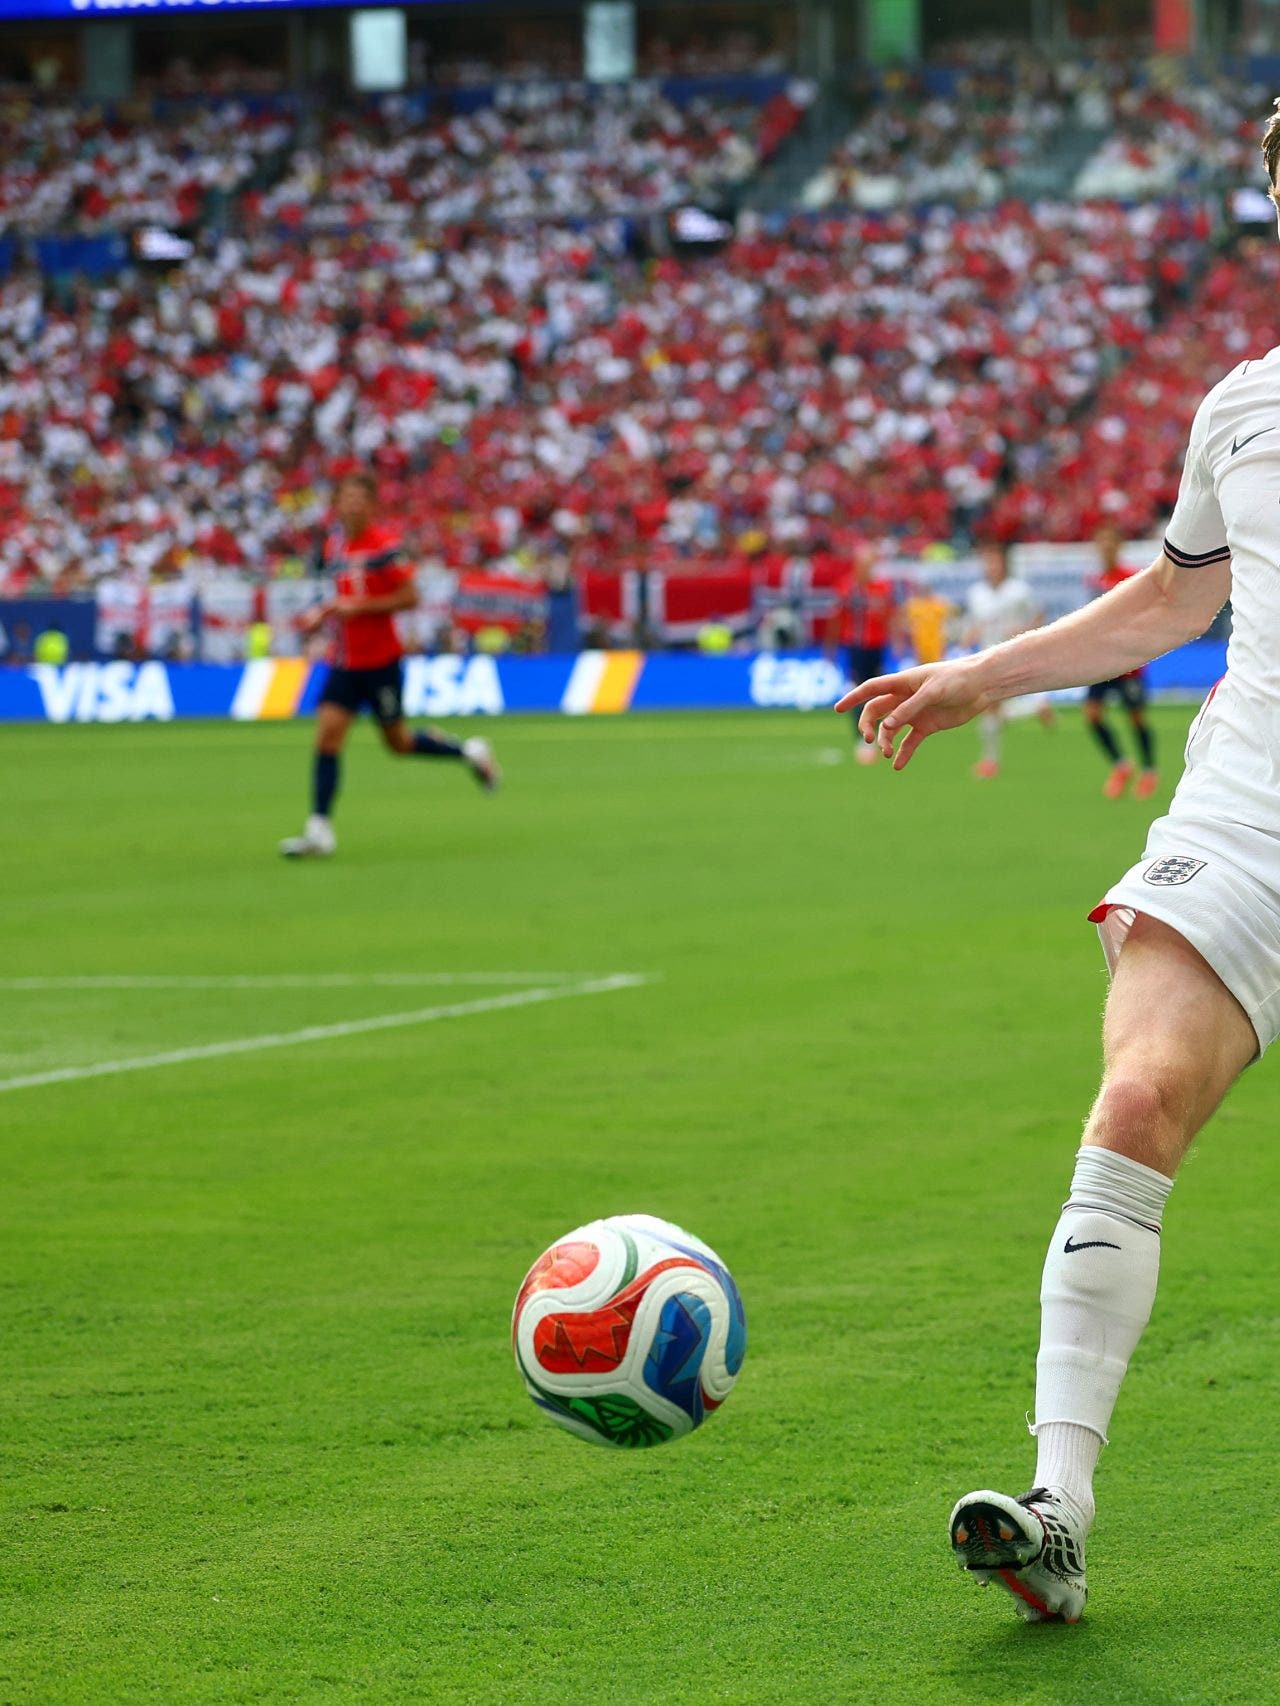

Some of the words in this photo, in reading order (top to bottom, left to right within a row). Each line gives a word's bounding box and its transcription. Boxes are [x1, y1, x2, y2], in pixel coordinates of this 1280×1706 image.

[28, 660, 176, 723] VISA
[402, 653, 505, 717] ISA
[751, 651, 844, 709] tap
